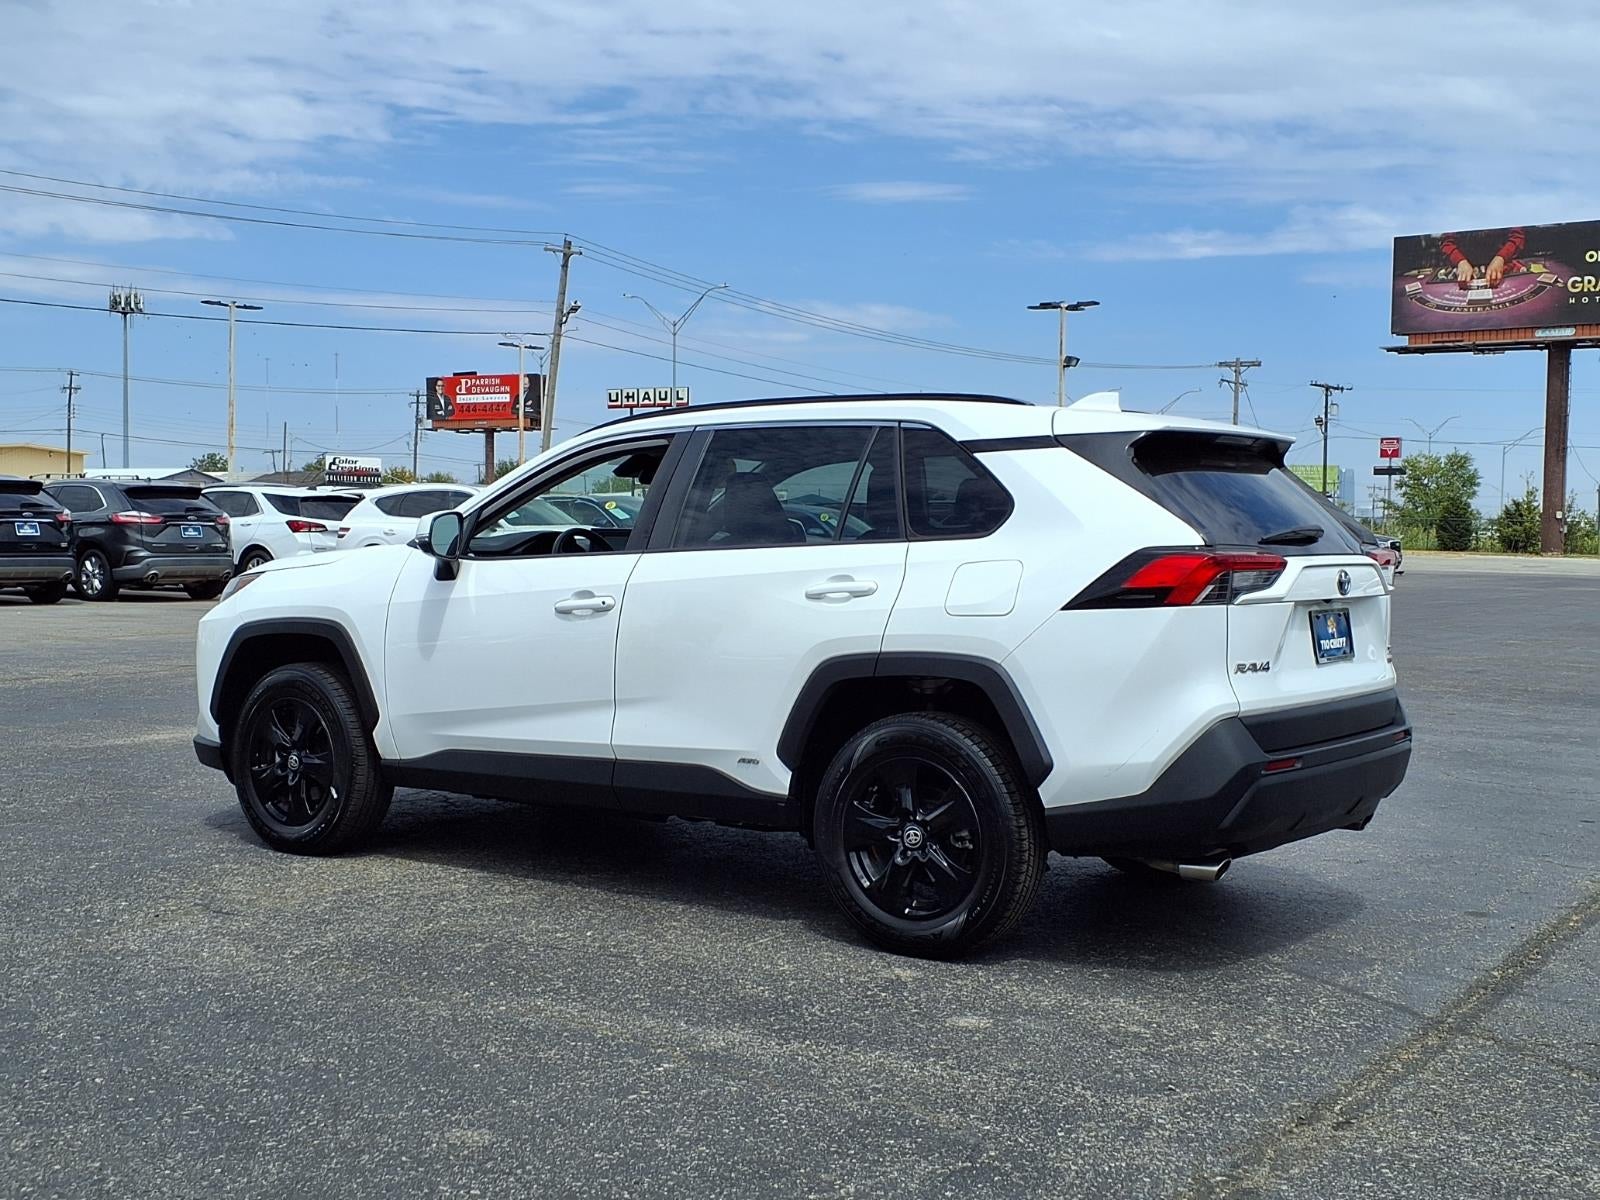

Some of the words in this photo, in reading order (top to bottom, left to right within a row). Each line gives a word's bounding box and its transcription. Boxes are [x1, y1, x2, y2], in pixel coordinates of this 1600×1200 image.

[471, 377, 500, 385] PARRISH
[471, 385, 510, 394] DEVAUGHN
[458, 403, 507, 413] 444-4444
[332, 456, 359, 465] Color
[328, 461, 380, 472] Creations
[1234, 661, 1270, 674] RAV4
